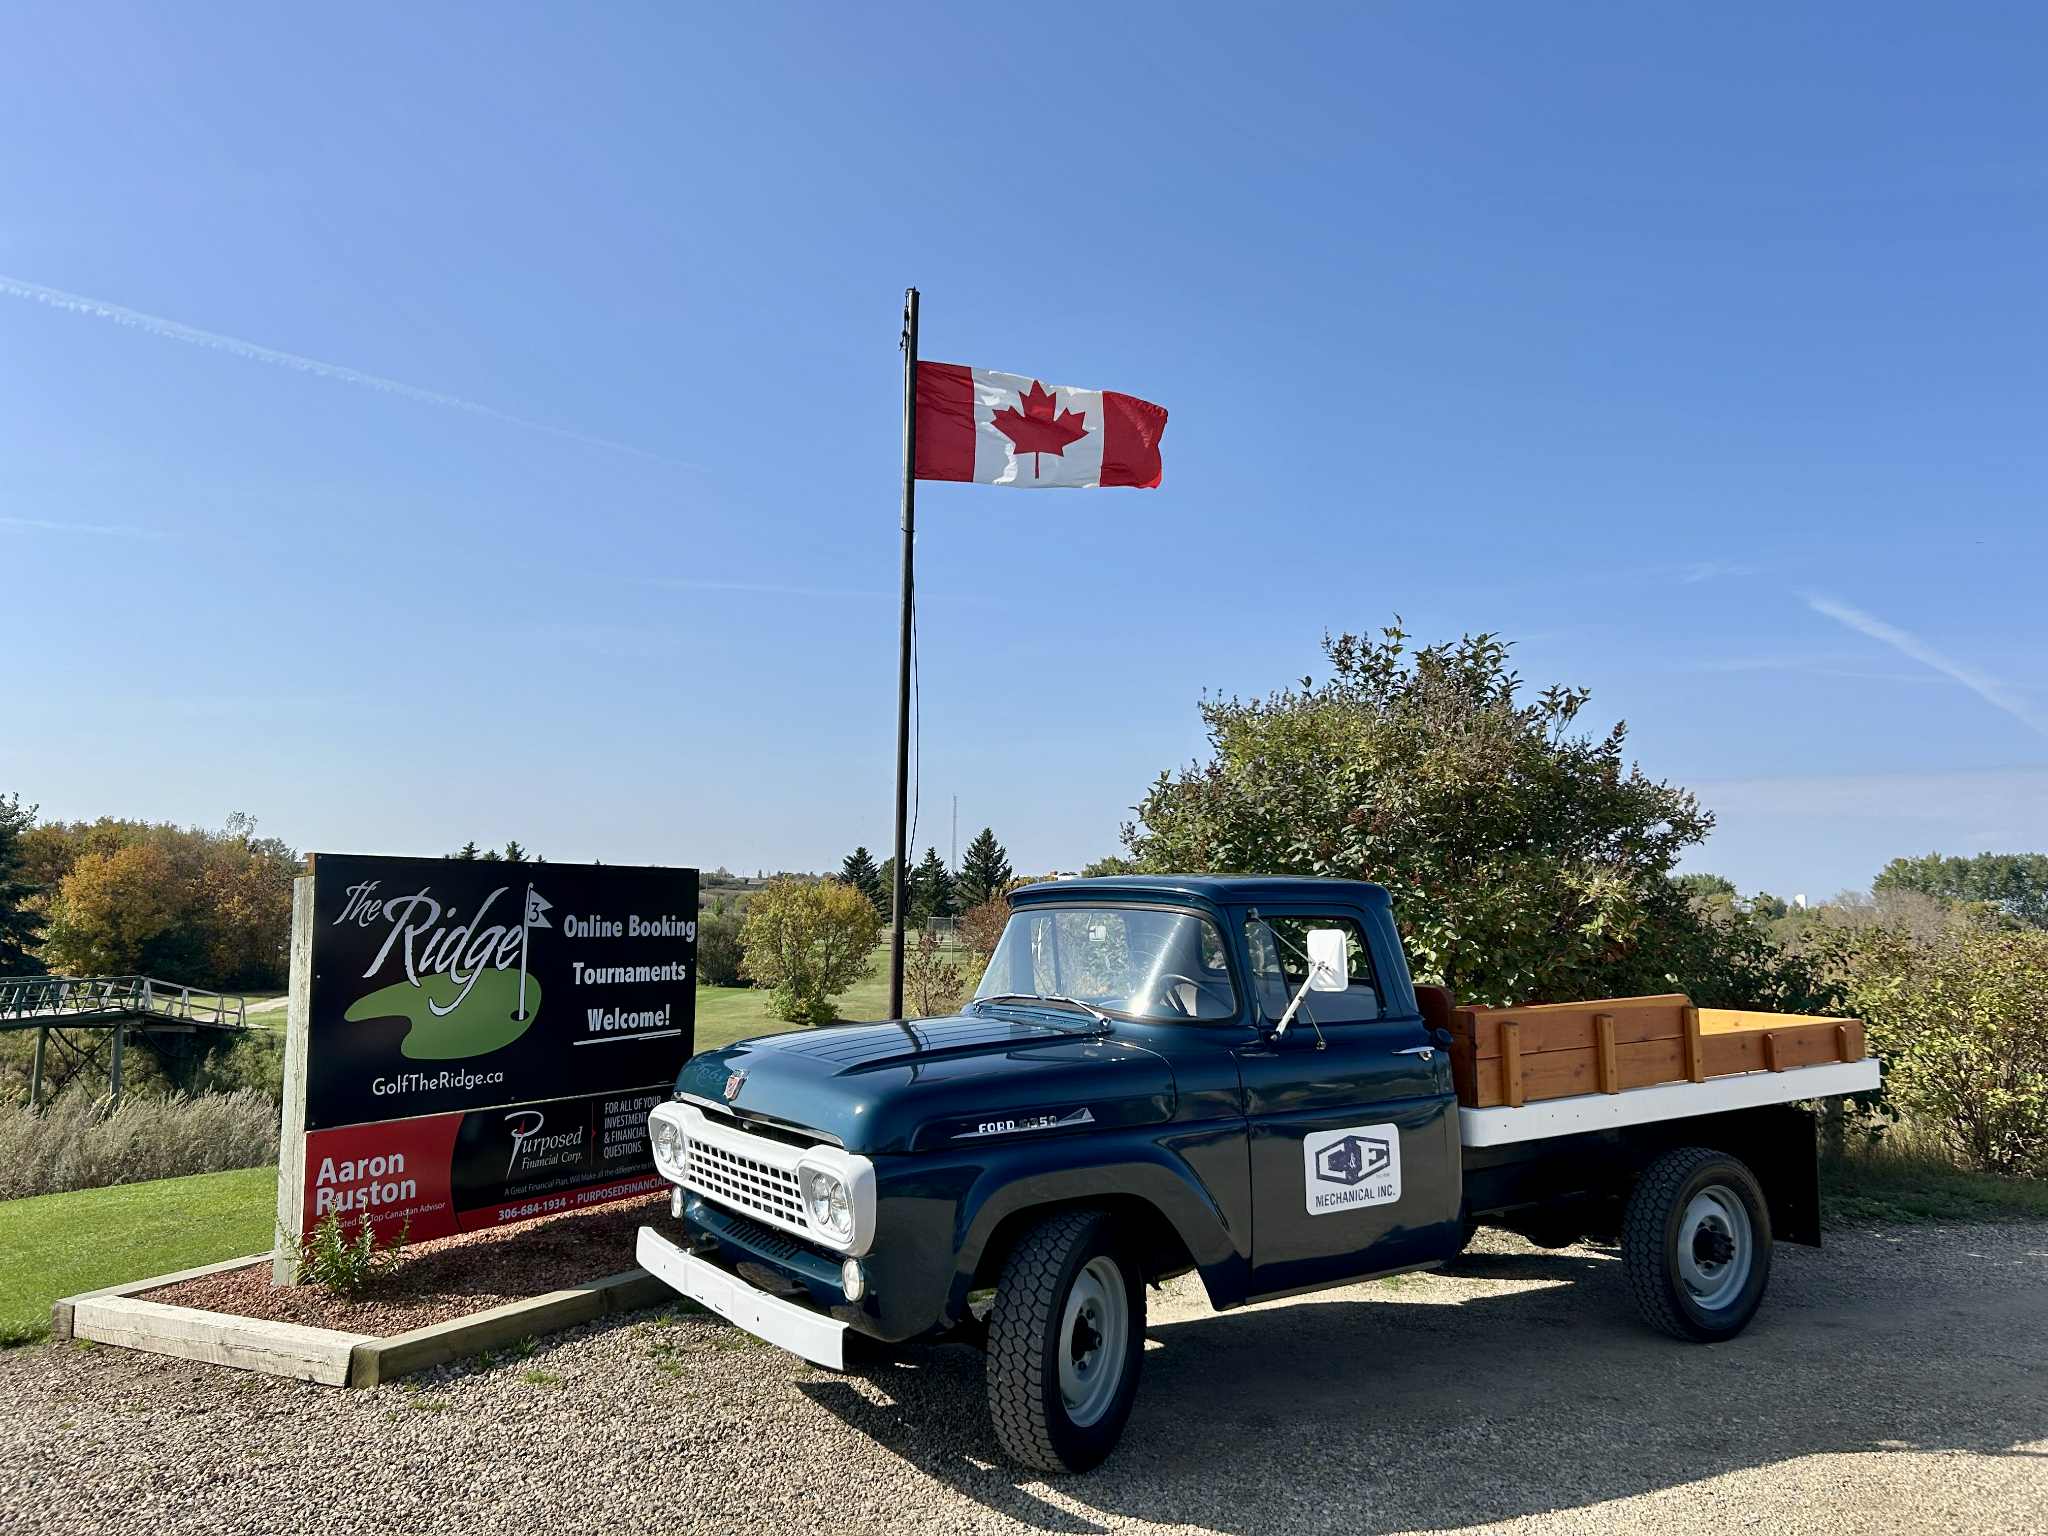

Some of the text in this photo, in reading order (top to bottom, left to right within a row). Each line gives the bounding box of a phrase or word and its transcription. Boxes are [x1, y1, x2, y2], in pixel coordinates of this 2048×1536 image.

[332, 879, 382, 928] The
[563, 913, 696, 943] Online Booking
[362, 887, 524, 1016] Ridge
[573, 961, 686, 985] Tournaments
[587, 1004, 671, 1032] Welcome!
[372, 1068, 504, 1096] GolfTheRidge.ca
[604, 1101, 619, 1114] FOR
[620, 1099, 632, 1112] ALL
[633, 1097, 642, 1110] OF
[603, 1126, 647, 1144] & FINANCIAL
[604, 1112, 647, 1130] INVESTMENT
[978, 1119, 1015, 1134] FORD
[505, 1110, 583, 1178] Purposed
[316, 1152, 405, 1187] Aaron
[522, 1151, 583, 1170] Financial Corp.
[316, 1179, 417, 1216] Ruston
[498, 1177, 671, 1221] 306-684-1934 PURPOSEDFINANCIAL
[1315, 1184, 1396, 1208] MECHANICAL INC.
